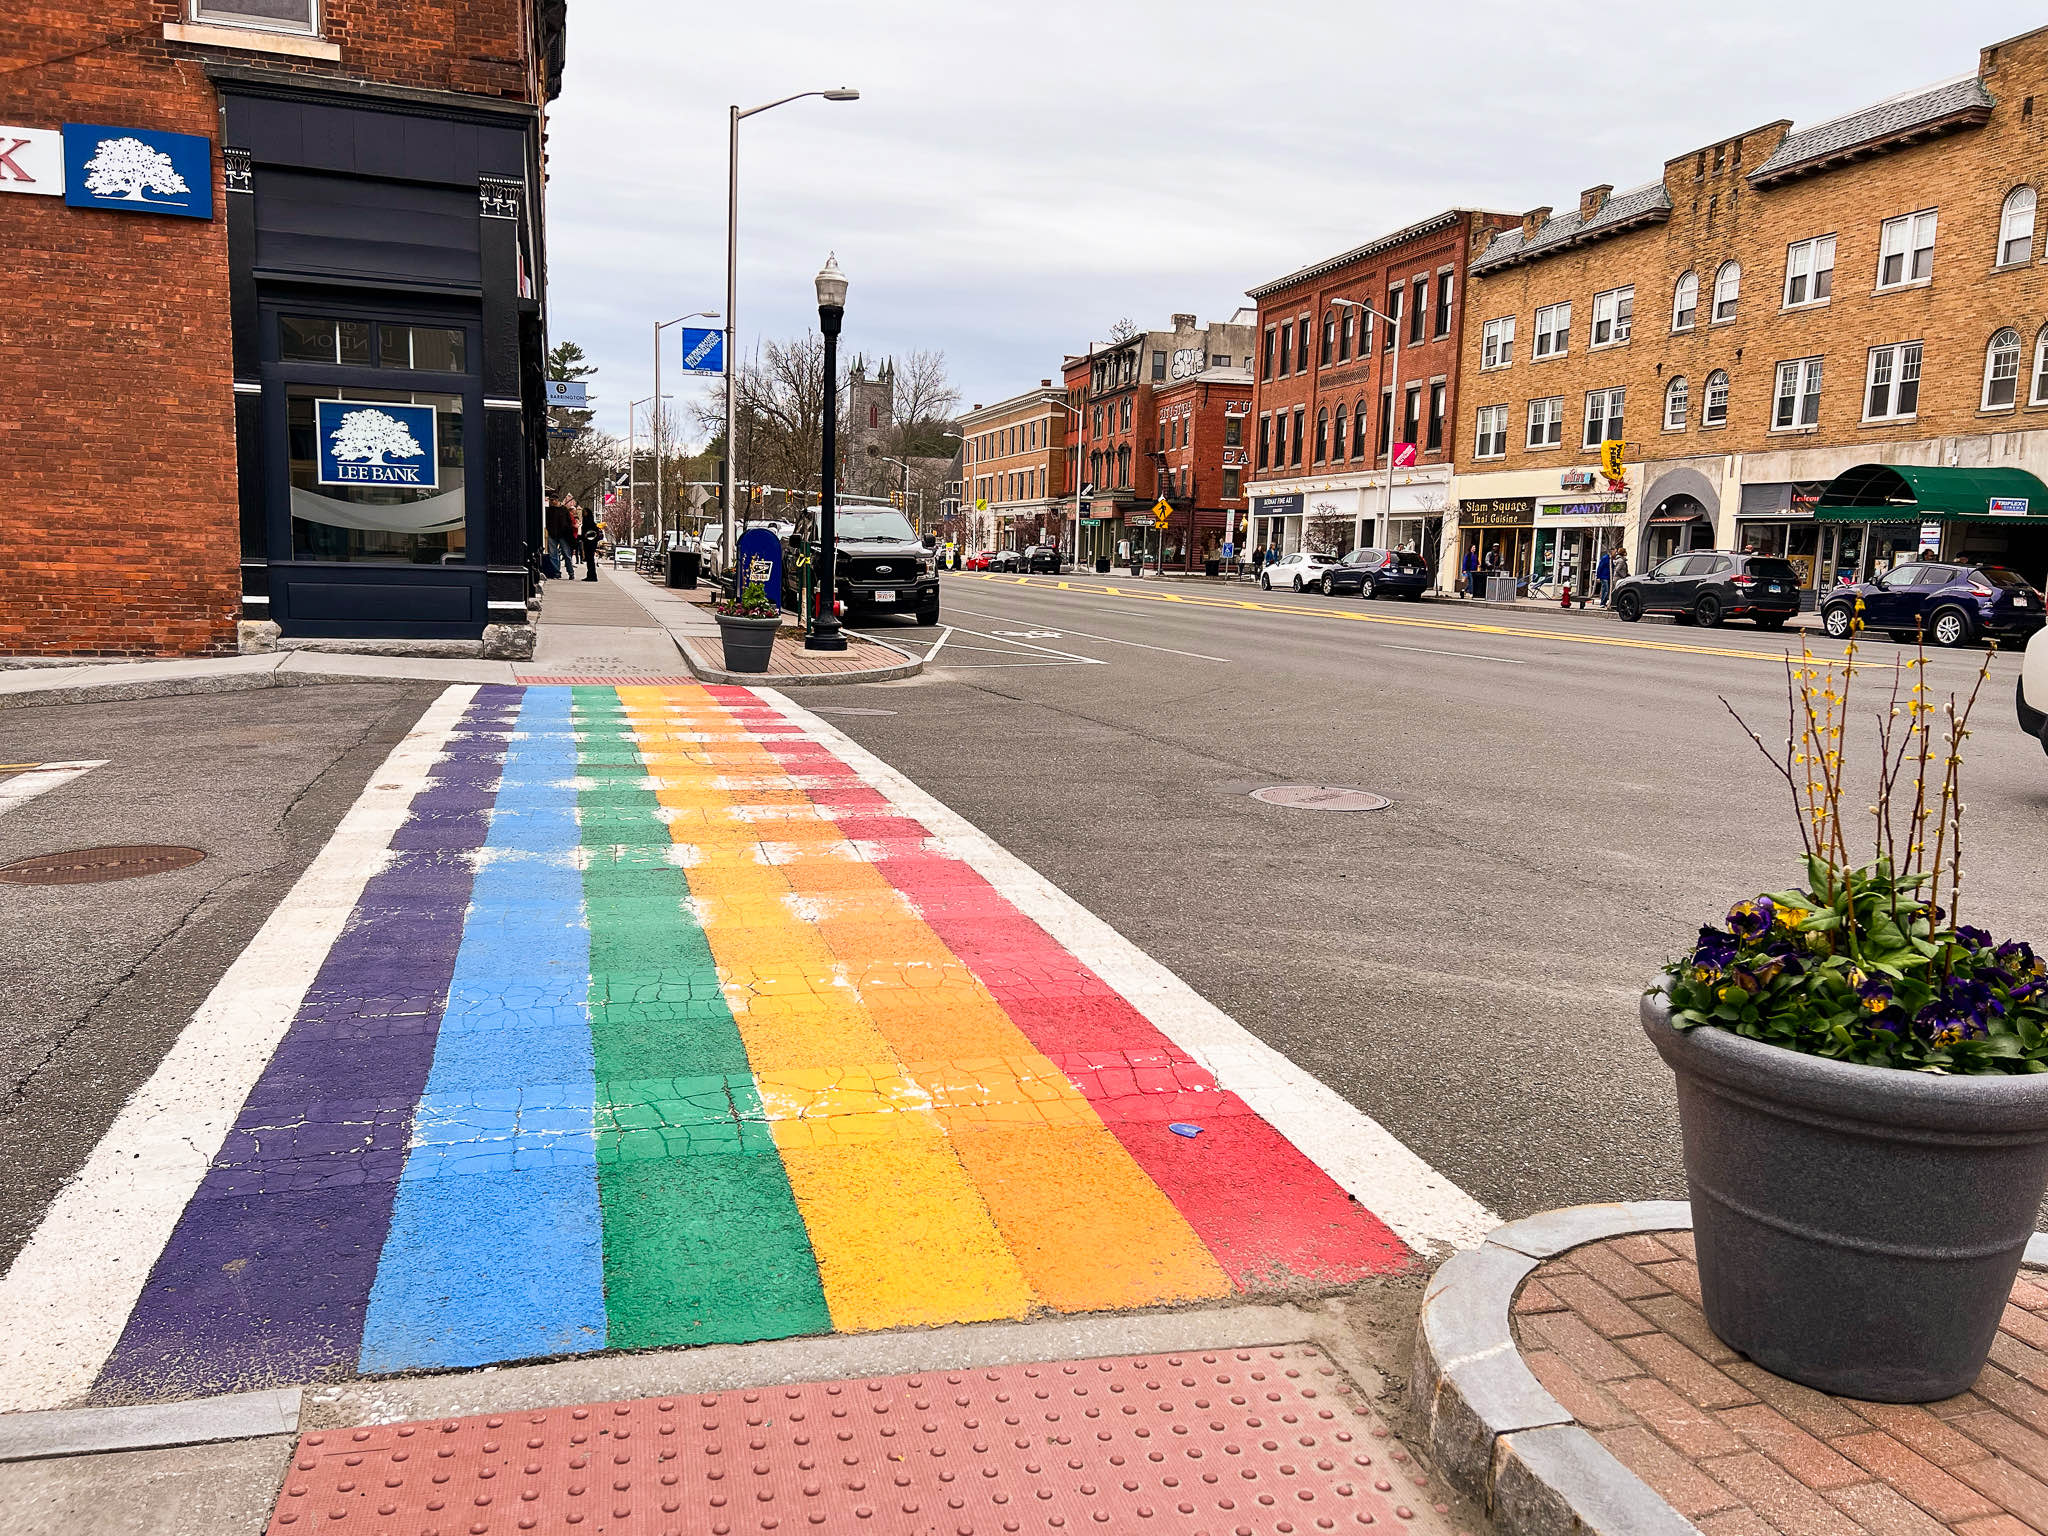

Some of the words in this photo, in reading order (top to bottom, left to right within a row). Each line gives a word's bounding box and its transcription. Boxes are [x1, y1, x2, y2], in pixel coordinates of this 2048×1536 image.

[1225, 400, 1252, 414] FU
[1223, 450, 1250, 465] CA
[337, 465, 369, 480] LEE
[371, 466, 420, 482] BANK
[1466, 501, 1488, 512] Siam
[1492, 500, 1528, 514] Square
[1563, 503, 1603, 514] CANDY
[1471, 513, 1488, 524] Thai
[1490, 513, 1518, 523] Cuisine
